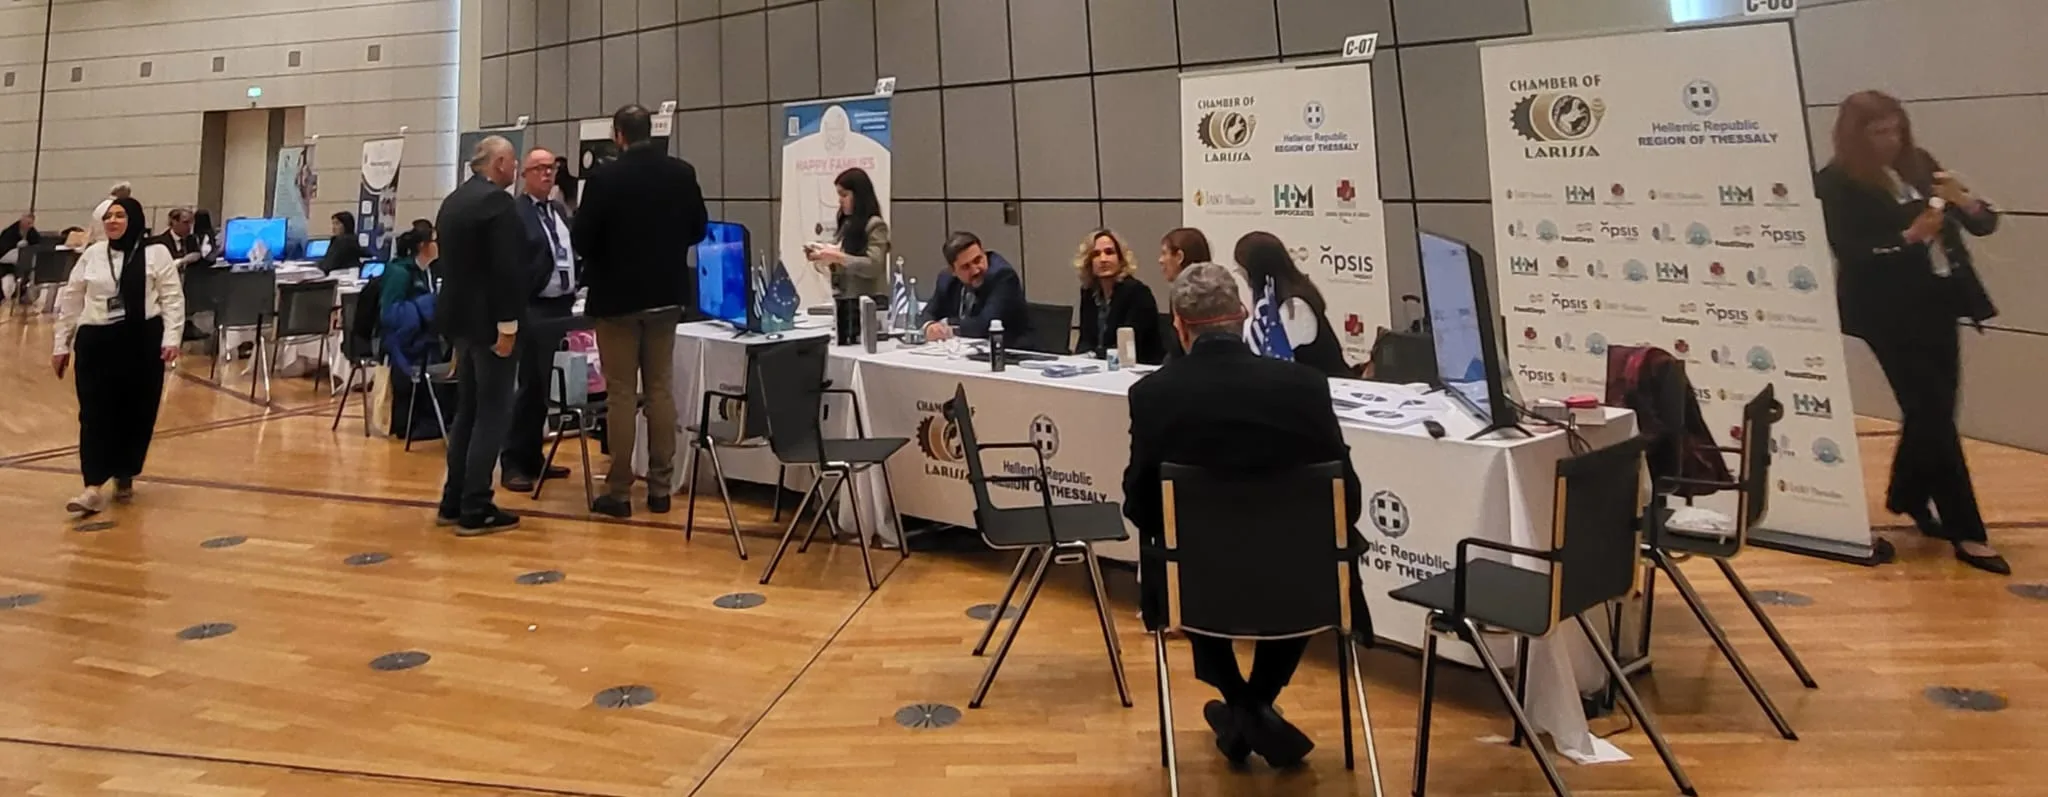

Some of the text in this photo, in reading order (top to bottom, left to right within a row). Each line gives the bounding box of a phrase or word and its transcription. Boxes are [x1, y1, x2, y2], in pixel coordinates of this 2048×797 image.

[1345, 38, 1373, 56] C-07
[1510, 75, 1602, 92] CHAMBER OF
[1198, 96, 1255, 109] CHAMBER OF
[1652, 120, 1758, 133] Hellenic Republic
[1283, 132, 1348, 143] Hellenic Republic
[1638, 133, 1778, 146] REGION OF THESSALY
[1275, 143, 1358, 153] REGION OF THESSALY
[1524, 145, 1600, 159] LARISSA
[1205, 152, 1251, 163] LARISSA
[1390, 544, 1451, 571] Republic
[1374, 557, 1392, 572] OF
